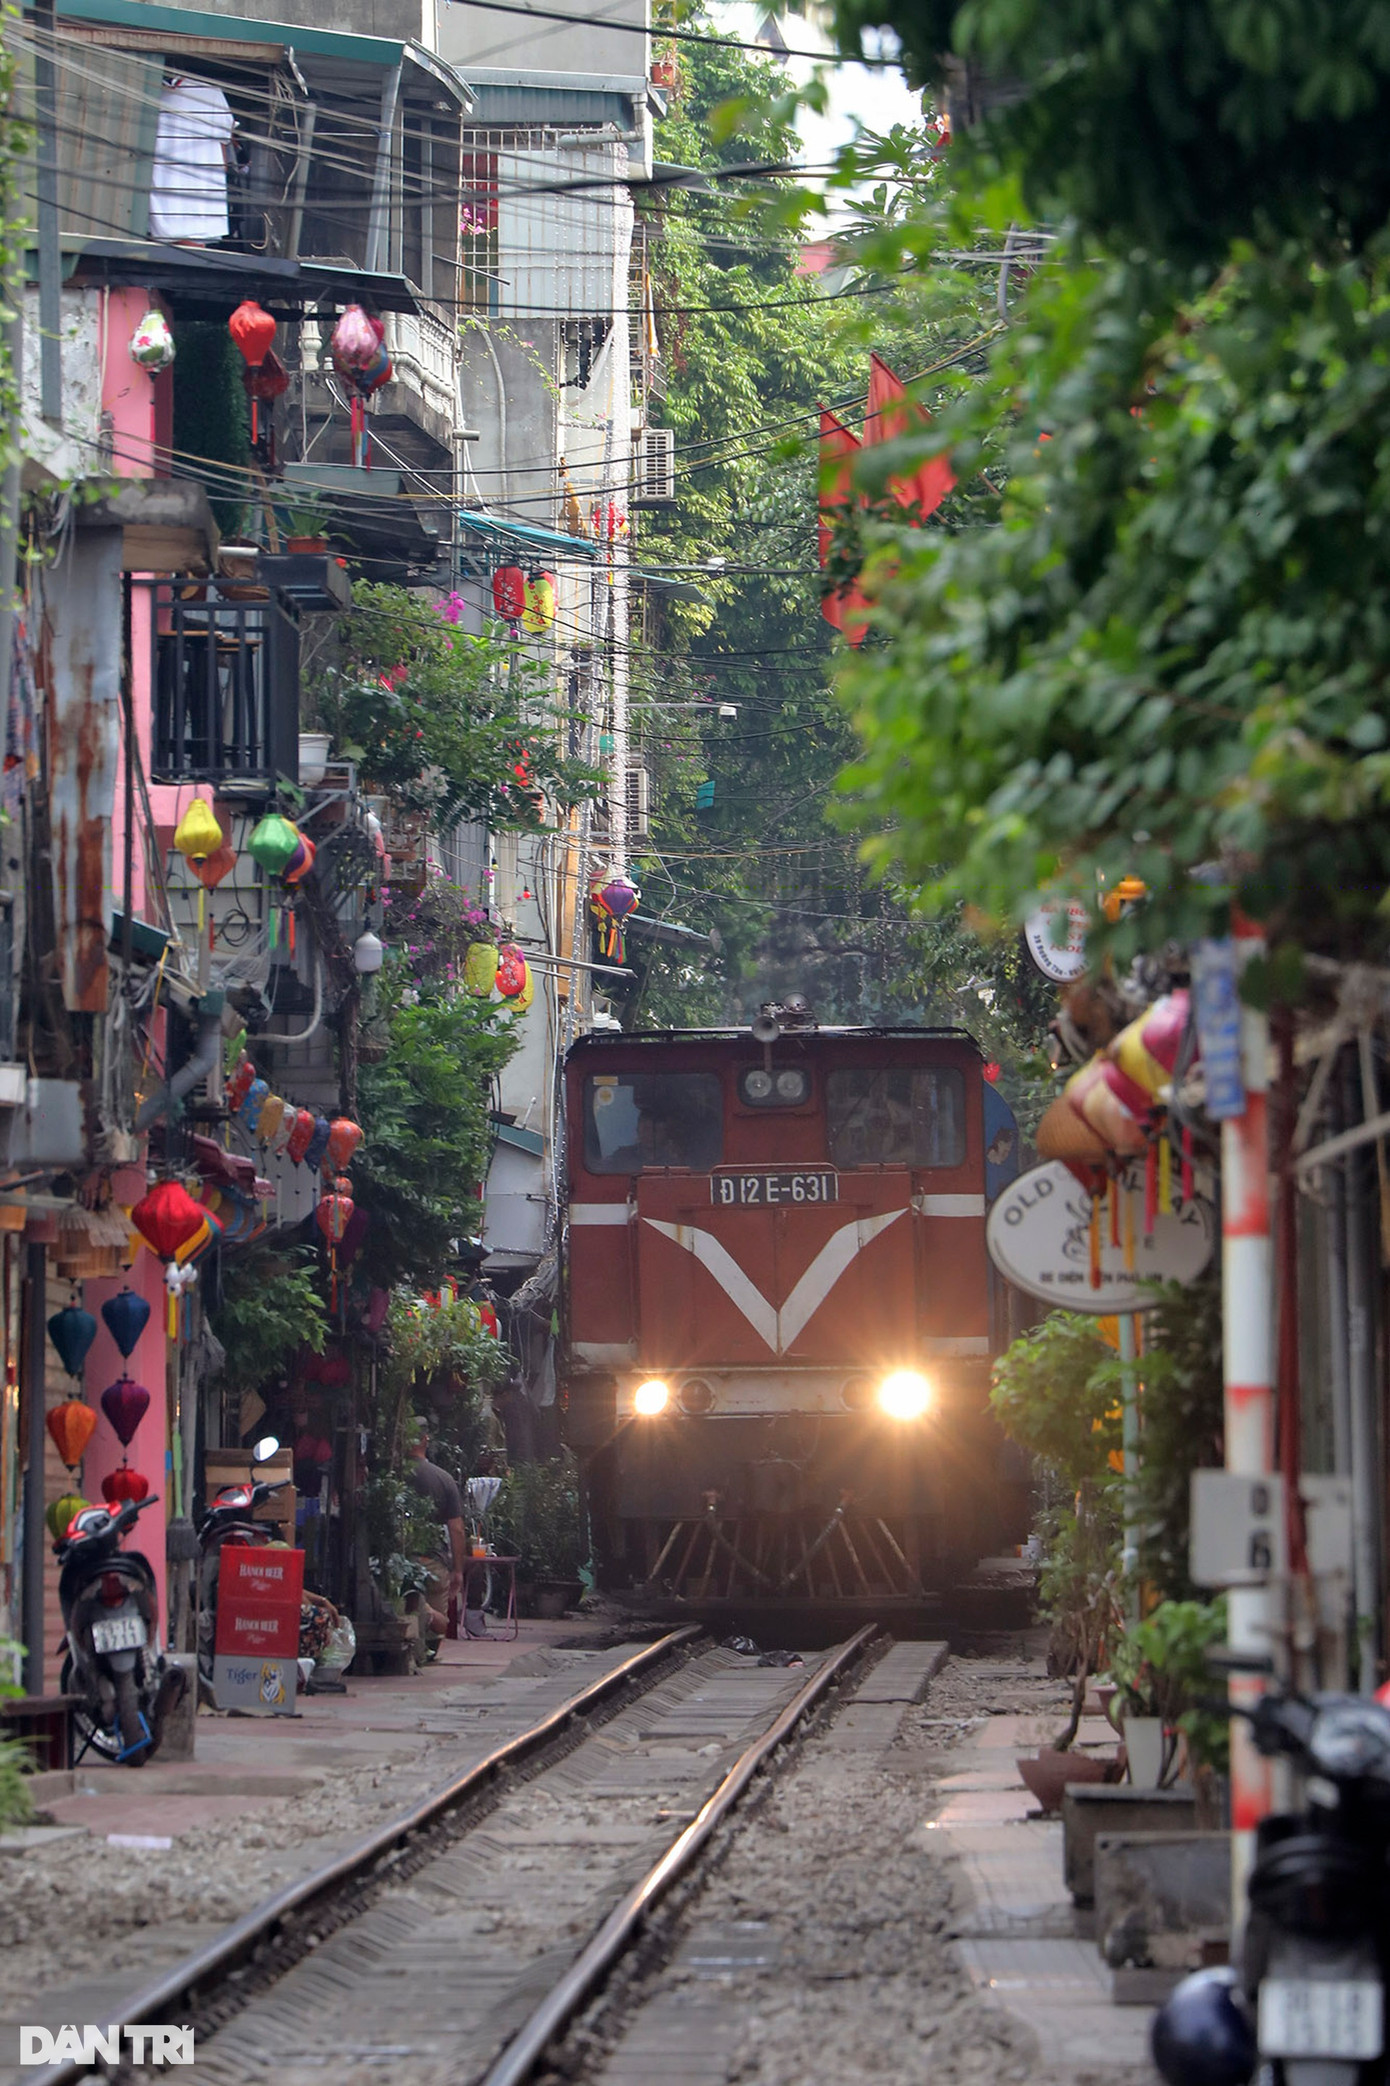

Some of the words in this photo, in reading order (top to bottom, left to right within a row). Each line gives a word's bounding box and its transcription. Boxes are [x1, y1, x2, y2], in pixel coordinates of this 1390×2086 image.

[1004, 1177, 1054, 1226] OLD
[239, 1562, 264, 1577] HANOI
[265, 1566, 283, 1580] BEER
[235, 1616, 260, 1631] HANOI
[260, 1620, 279, 1634] BEER
[227, 1668, 258, 1685] Tiger
